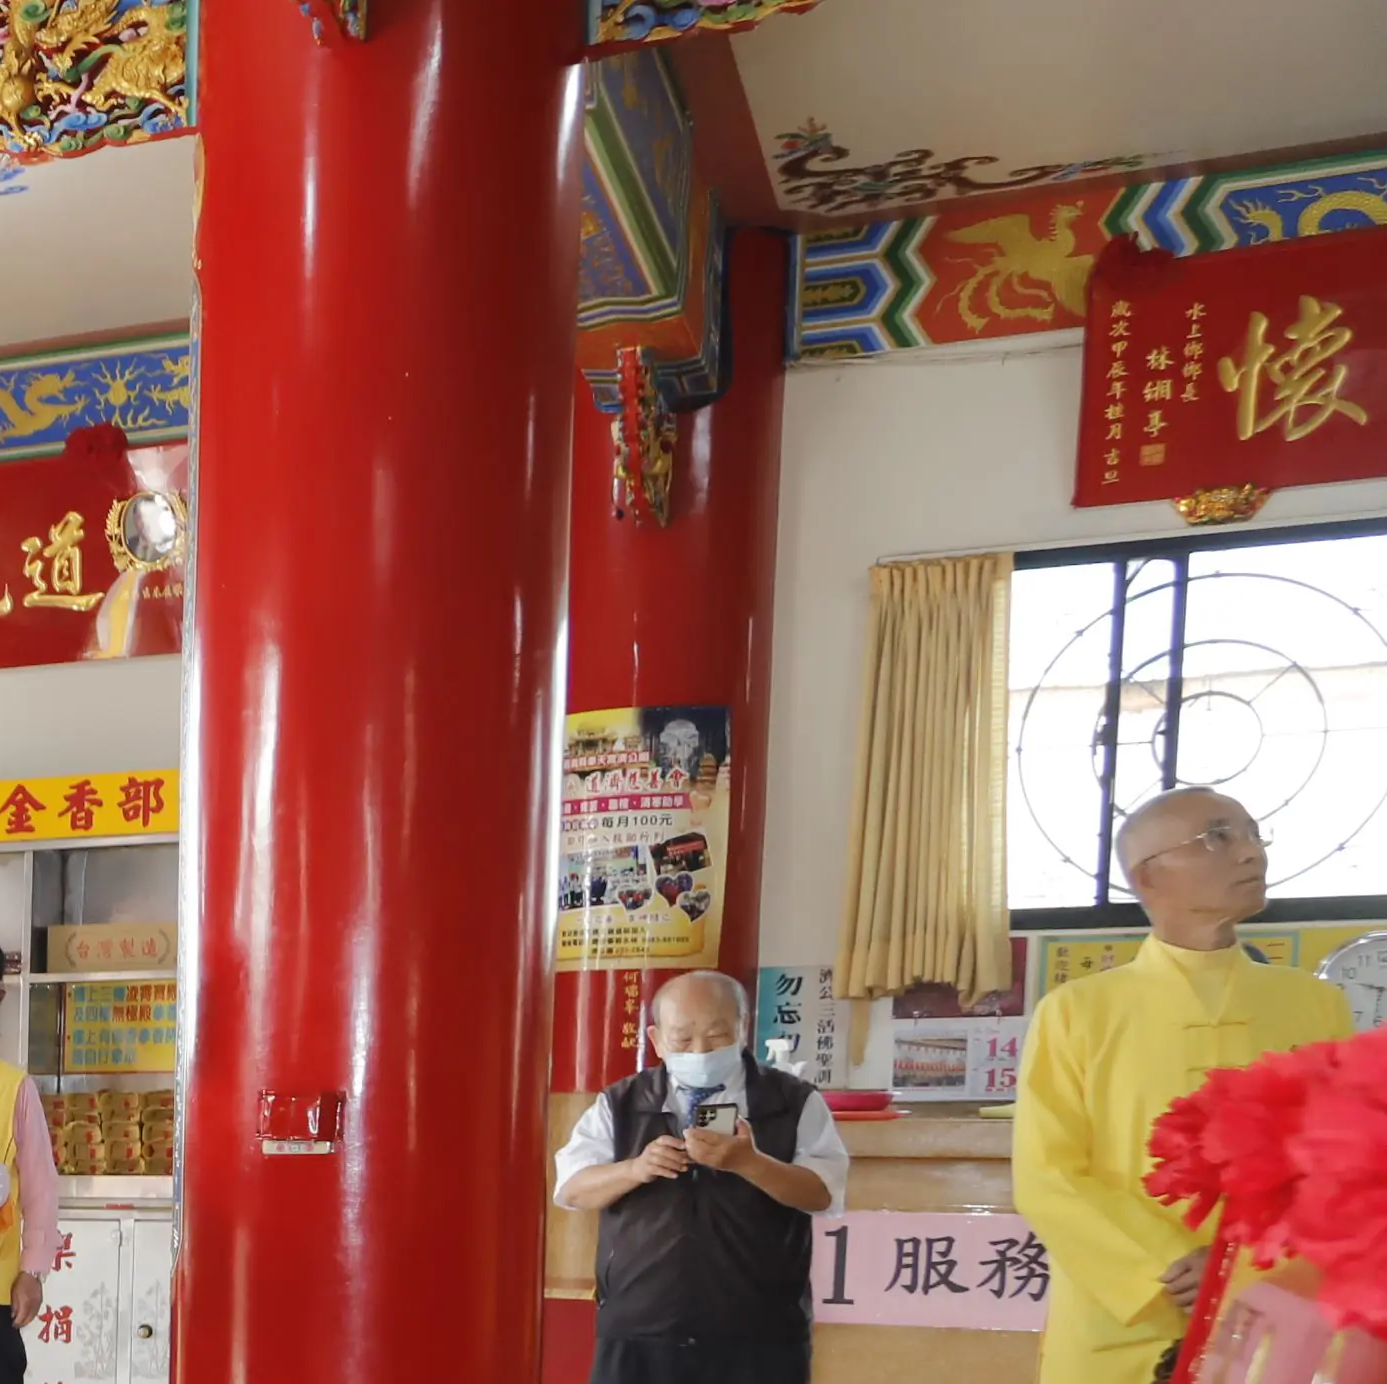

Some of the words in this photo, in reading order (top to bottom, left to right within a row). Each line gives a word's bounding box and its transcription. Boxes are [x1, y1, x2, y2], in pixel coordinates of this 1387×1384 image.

[987, 1036, 1017, 1058] 14
[986, 1067, 1017, 1088] 15
[883, 1230, 1051, 1302] 服務
